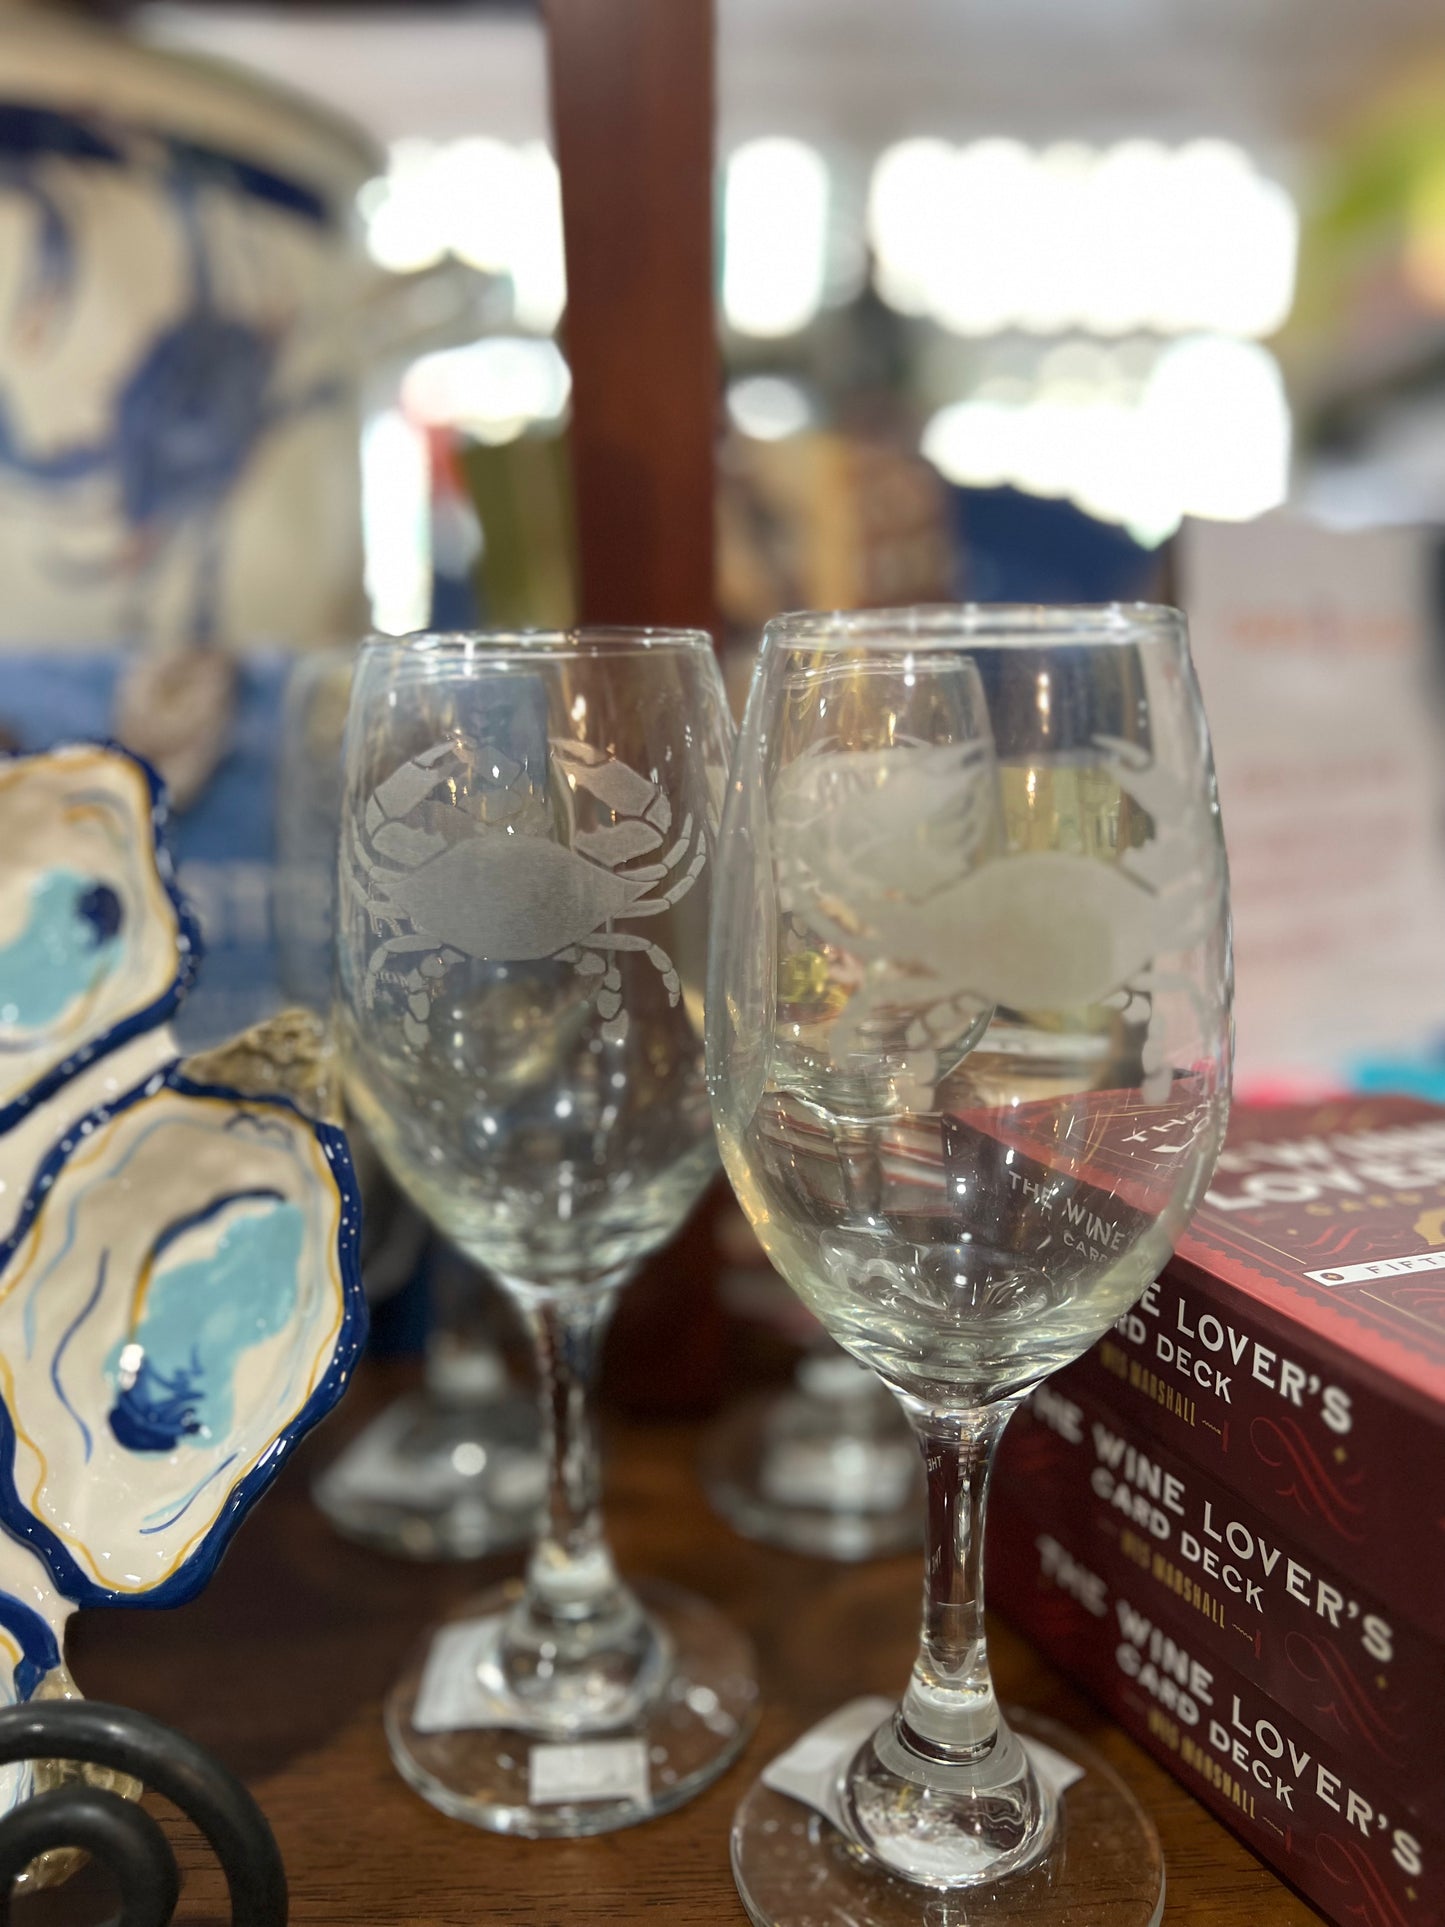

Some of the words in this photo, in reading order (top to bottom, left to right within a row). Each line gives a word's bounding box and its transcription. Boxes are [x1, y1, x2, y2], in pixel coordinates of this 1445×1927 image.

[1009, 1170, 1053, 1211] THE
[1065, 1198, 1125, 1251] WINE
[1365, 1256, 1445, 1274] FIFT
[1156, 1332, 1232, 1404] DECK
[1177, 1297, 1353, 1434] LOVER'S
[1090, 1466, 1171, 1540] CARD
[1180, 1530, 1264, 1614] DECK
[1091, 1420, 1186, 1516] WINE
[1203, 1500, 1393, 1662] LOVER'S
[1114, 1642, 1200, 1726] CARD
[1209, 1718, 1295, 1813] DECK
[1115, 1598, 1214, 1706] WINE
[1231, 1694, 1422, 1876] LOVER'S
